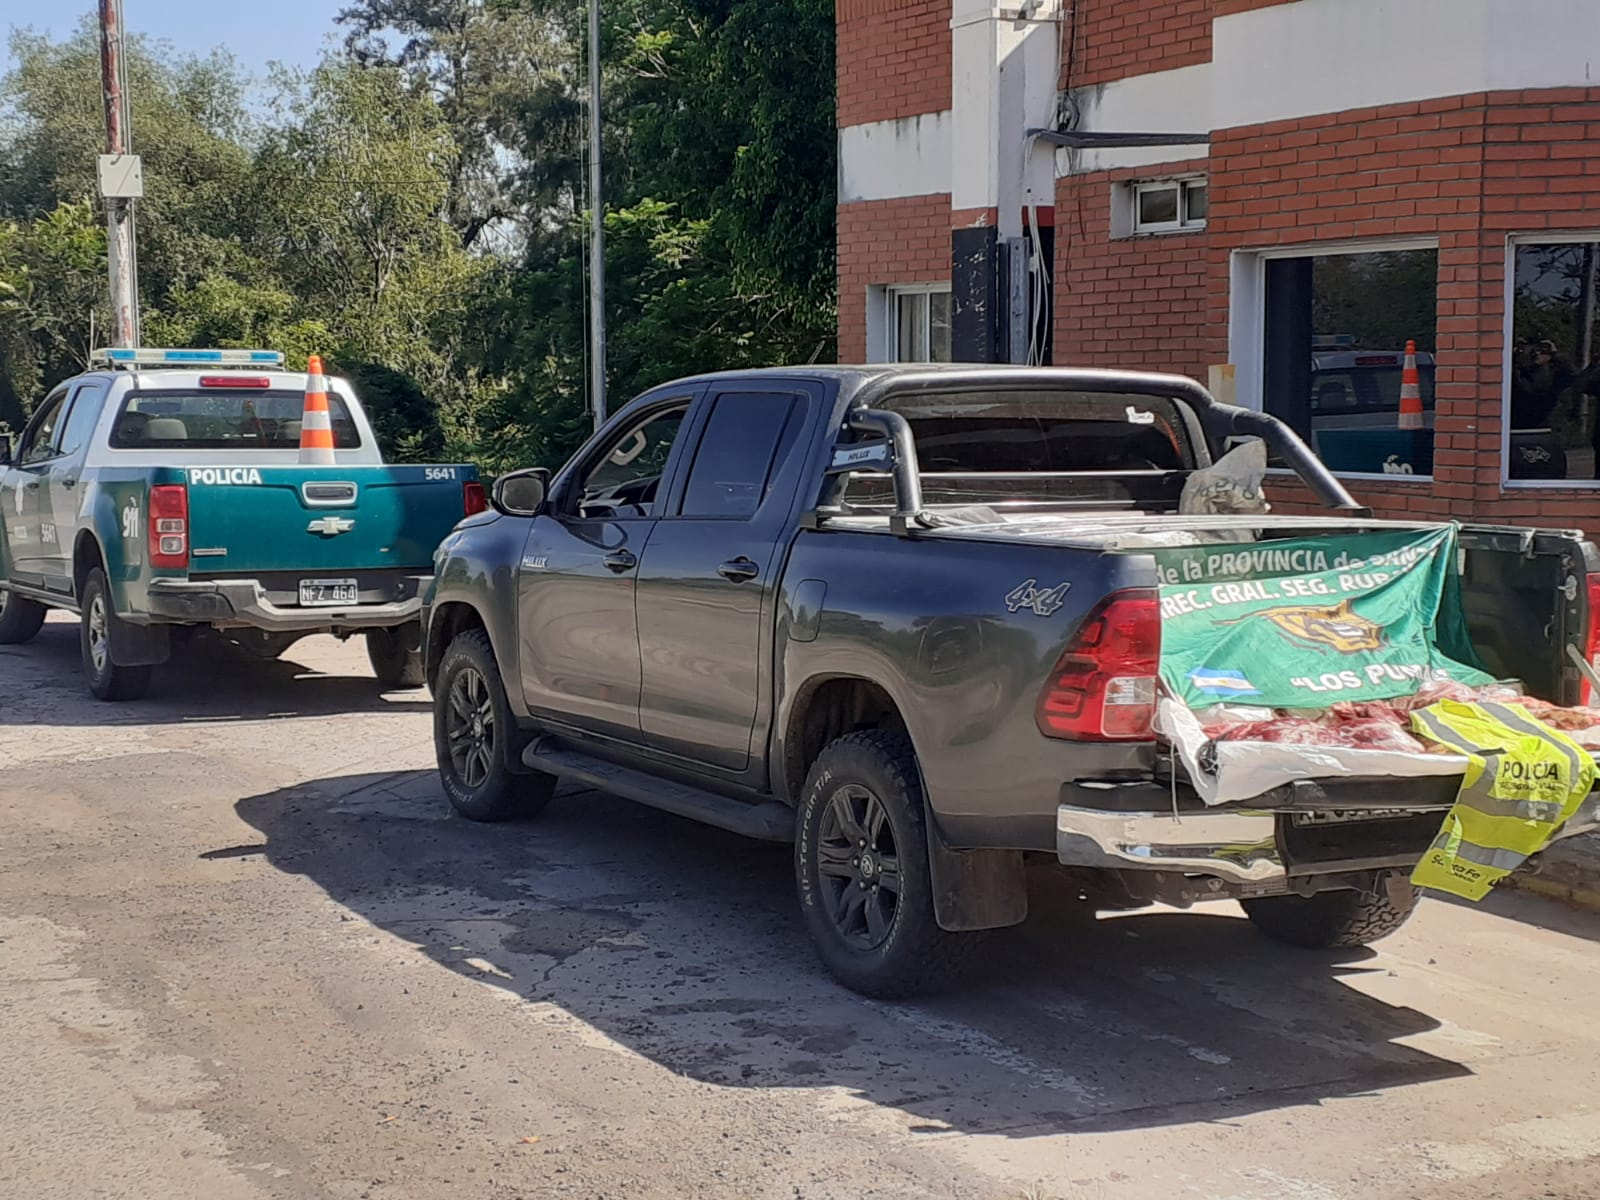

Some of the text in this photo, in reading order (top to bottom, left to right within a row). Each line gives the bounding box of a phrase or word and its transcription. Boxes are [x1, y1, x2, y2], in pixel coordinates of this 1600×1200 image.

[848, 449, 871, 460] HILUX
[190, 468, 262, 485] POLICIA
[424, 467, 456, 480] 5641
[122, 506, 139, 538] 911
[521, 554, 547, 568] HILUX
[1182, 557, 1203, 582] la
[1207, 549, 1329, 578] PROVINCIA
[302, 585, 355, 601] NFZ 464
[1212, 581, 1281, 605] GRAL.
[1280, 577, 1338, 597] SEG.
[815, 770, 832, 791] T/A
